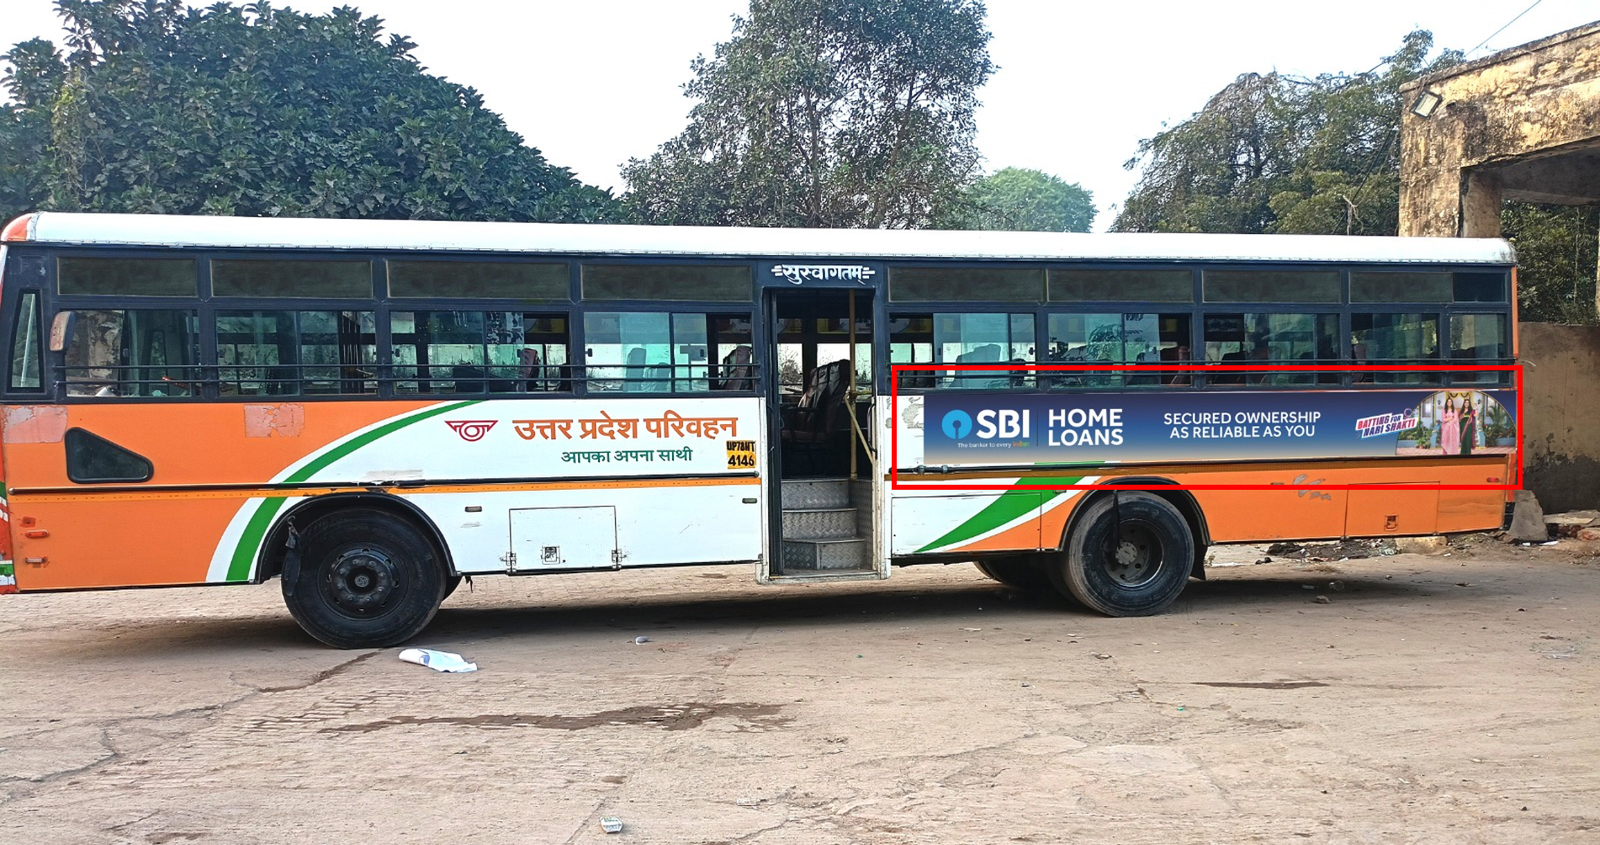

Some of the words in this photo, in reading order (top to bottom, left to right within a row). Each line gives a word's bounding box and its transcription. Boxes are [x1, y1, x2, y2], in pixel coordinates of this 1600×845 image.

[782, 264, 865, 285] सुस्वागतम्
[512, 419, 573, 440] उत्तर
[578, 410, 639, 439] प्रदेश
[643, 409, 738, 439] परिवहन
[976, 409, 1030, 439] SBI
[1048, 408, 1123, 428] HOME
[1164, 412, 1232, 425] SECURED
[1234, 411, 1321, 424] OWNERSHIP
[1357, 415, 1390, 430] BATTING
[1170, 427, 1189, 439] AS
[1193, 426, 1260, 438] RELIABLE
[1263, 425, 1281, 437] AS
[1285, 425, 1316, 437] YOU
[1363, 425, 1384, 437] NARI
[1385, 419, 1416, 432] SHAKTI
[726, 440, 755, 452] UP78HT
[1048, 429, 1124, 446] LOANS
[561, 450, 611, 463] आपका
[614, 450, 654, 462] अपना
[656, 446, 693, 461] साथी
[728, 454, 755, 466] 4146
